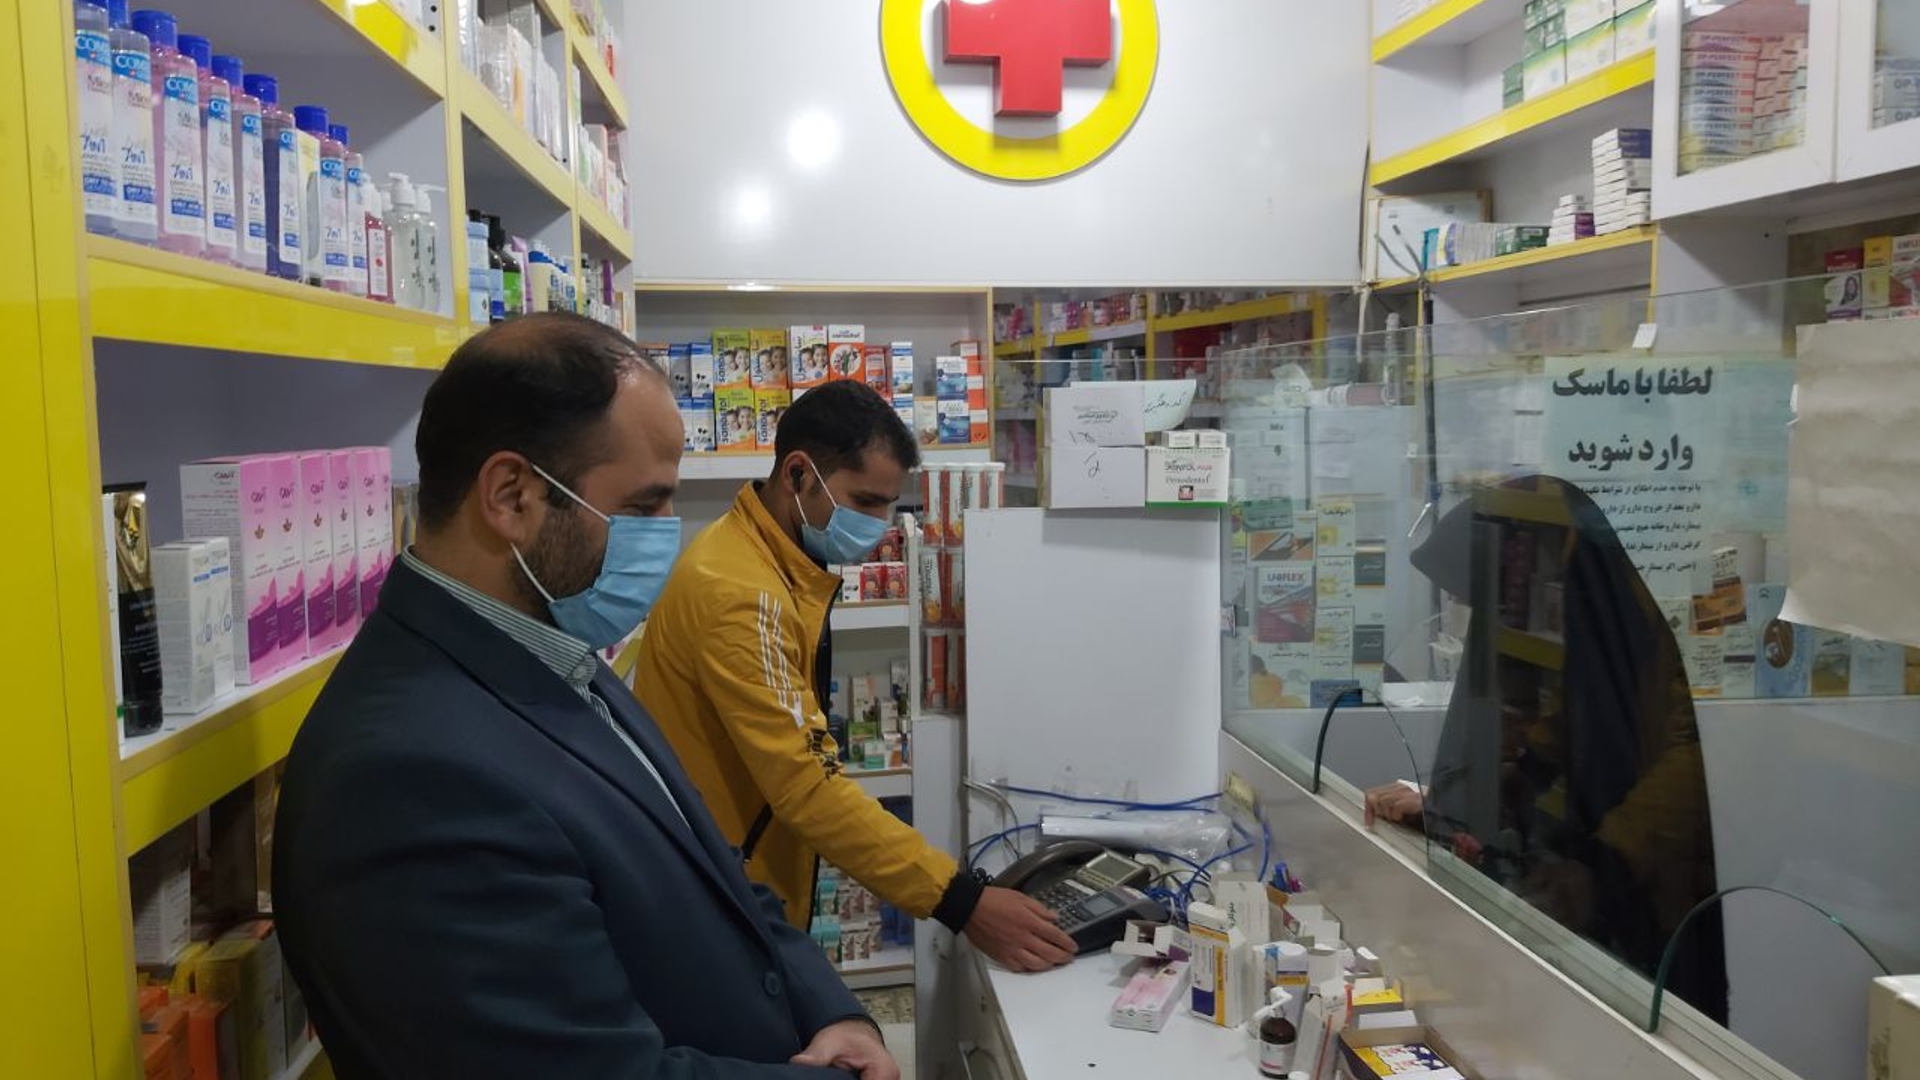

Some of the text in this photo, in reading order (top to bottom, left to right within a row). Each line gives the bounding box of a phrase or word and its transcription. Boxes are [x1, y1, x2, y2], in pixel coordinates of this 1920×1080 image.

[1552, 366, 1714, 403] لطفا با ماسک
[719, 397, 730, 443] sanostol
[759, 398, 770, 443] sanostol
[1568, 434, 1694, 471] وارد شوید
